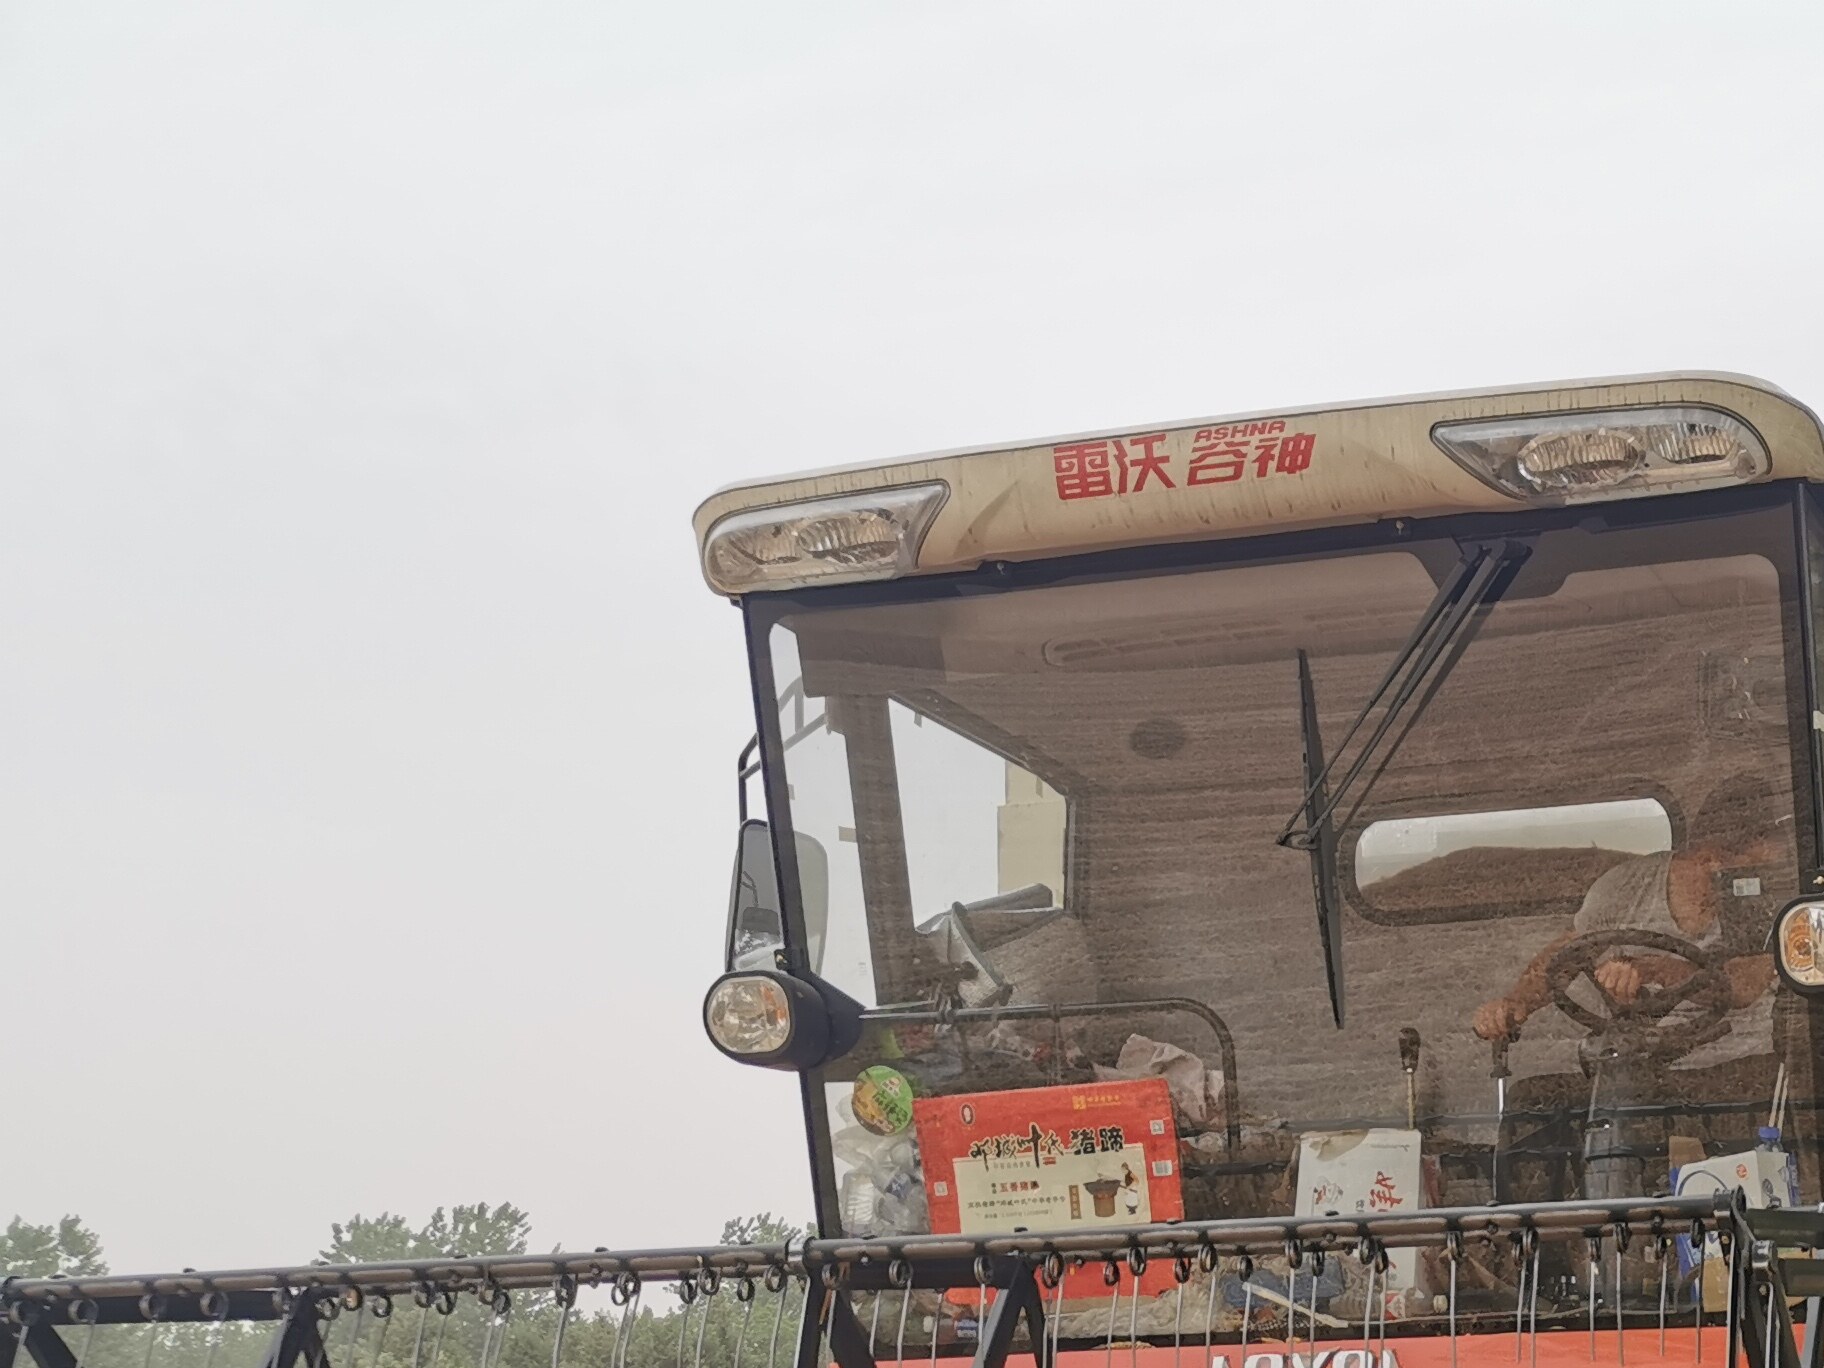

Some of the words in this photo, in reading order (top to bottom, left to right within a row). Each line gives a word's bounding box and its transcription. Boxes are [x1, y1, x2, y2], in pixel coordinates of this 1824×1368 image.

[1193, 420, 1287, 443] ASHNA
[1053, 431, 1318, 501] 雷沃谷神
